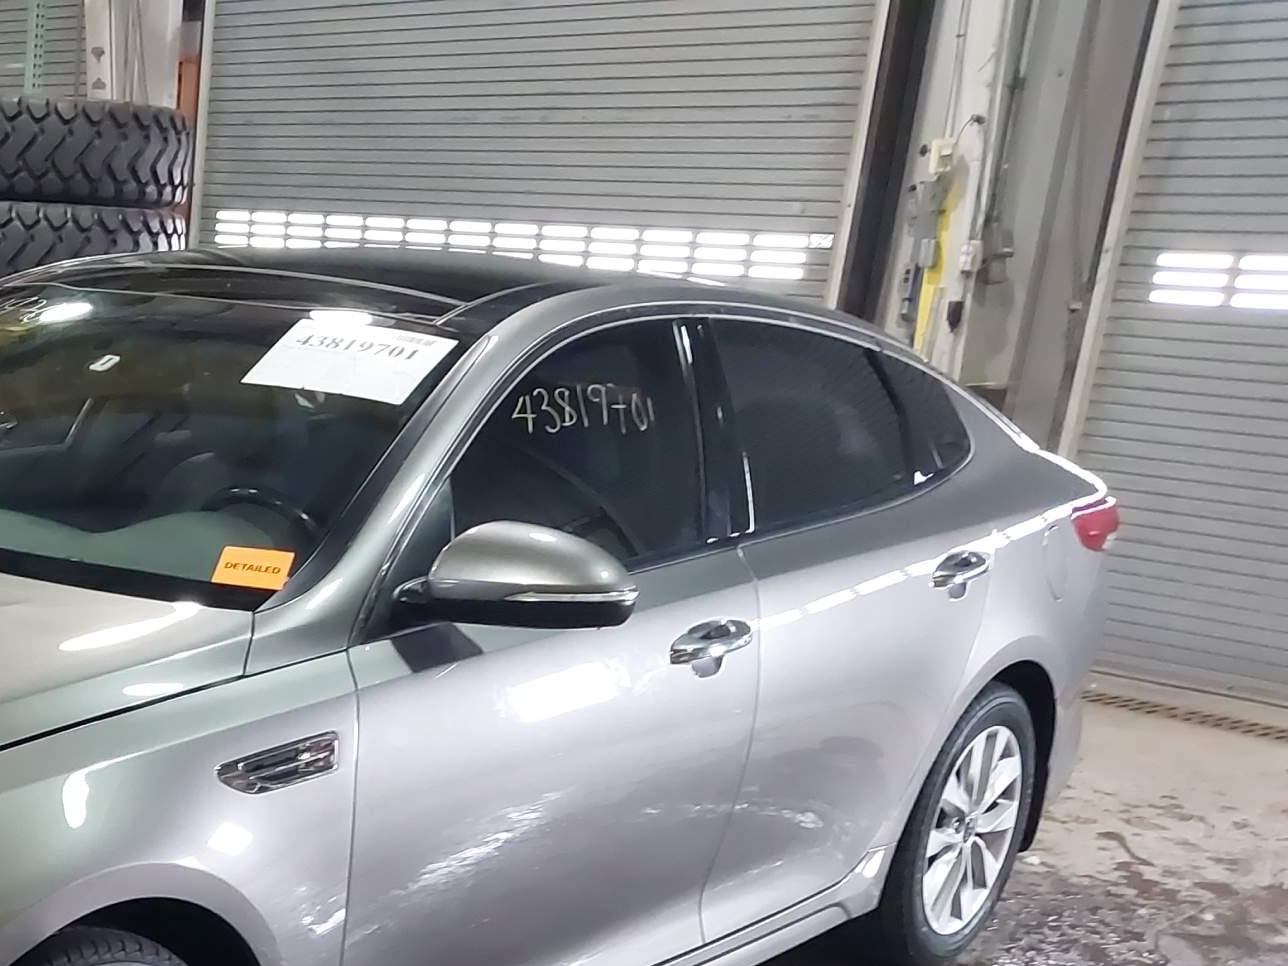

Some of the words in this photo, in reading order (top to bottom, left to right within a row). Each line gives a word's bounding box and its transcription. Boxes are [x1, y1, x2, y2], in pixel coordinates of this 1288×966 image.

[295, 333, 420, 361] 43819701
[511, 383, 655, 434] 43819701
[223, 561, 282, 575] DETAILED
